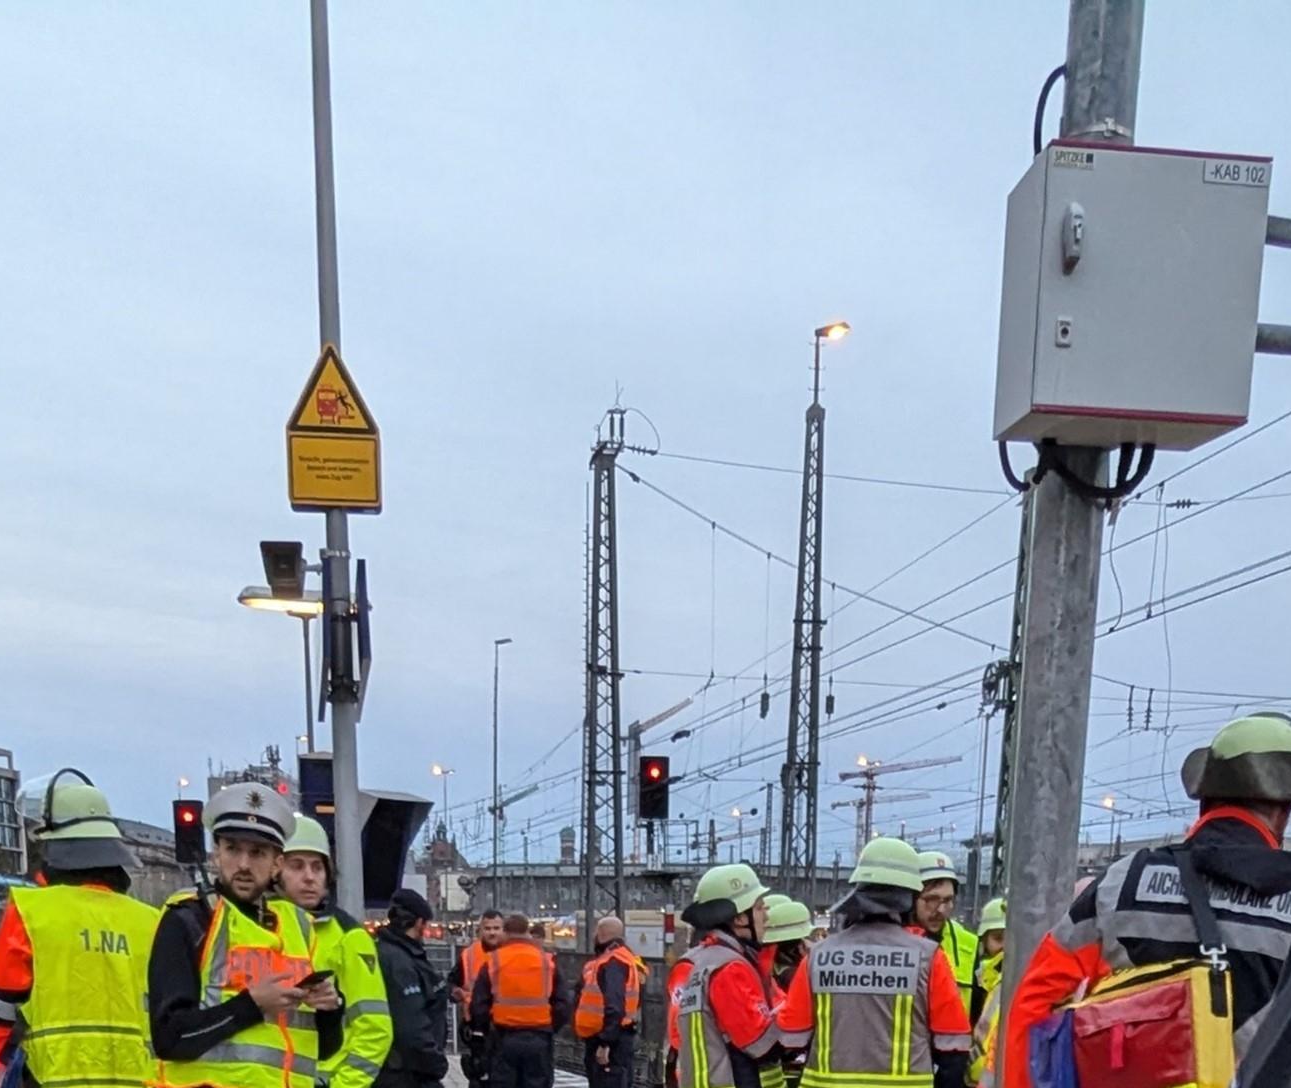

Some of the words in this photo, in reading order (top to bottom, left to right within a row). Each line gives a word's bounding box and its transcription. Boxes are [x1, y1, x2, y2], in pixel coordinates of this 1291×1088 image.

[1210, 164, 1240, 181] -KAB
[1246, 166, 1266, 183] 102
[1147, 871, 1186, 897] AICH
[1206, 878, 1273, 910] MBULANZ
[80, 928, 130, 956] 1.NA
[817, 950, 845, 966] UG
[851, 950, 916, 968] SanEL
[819, 970, 909, 989] München
